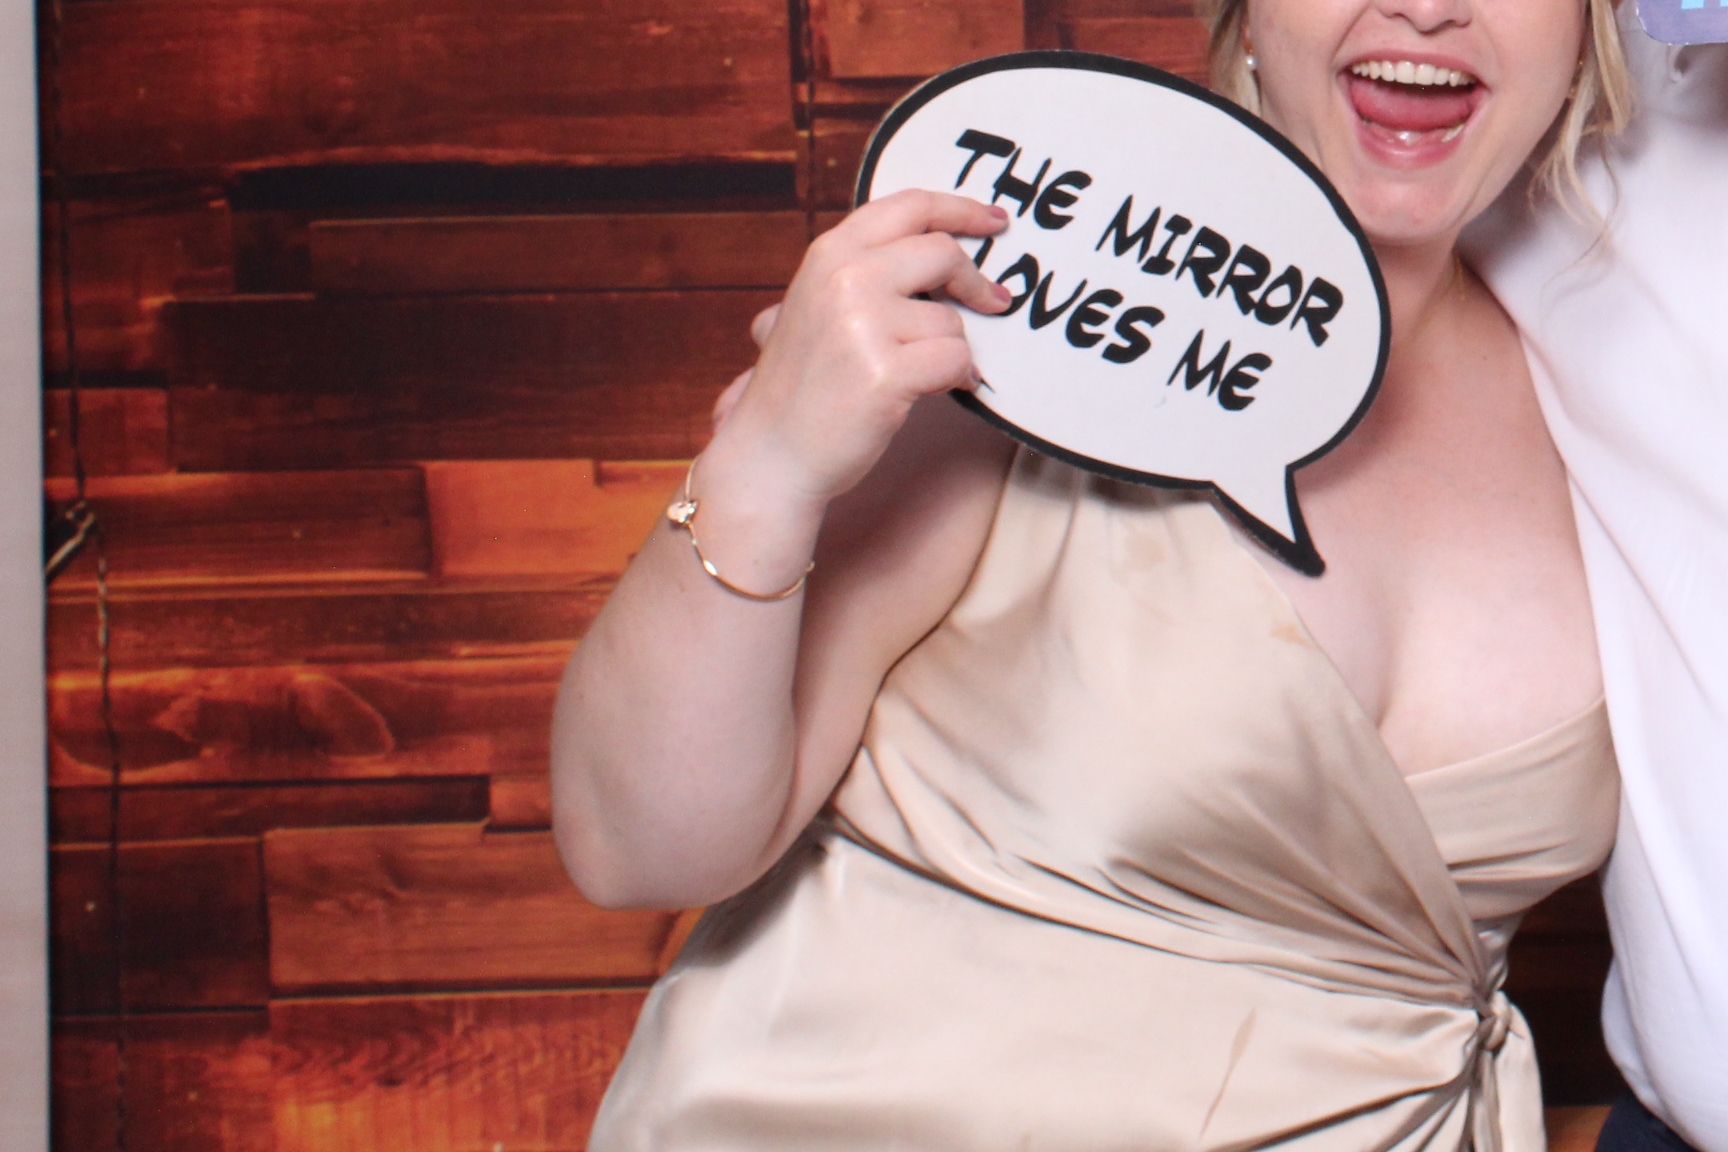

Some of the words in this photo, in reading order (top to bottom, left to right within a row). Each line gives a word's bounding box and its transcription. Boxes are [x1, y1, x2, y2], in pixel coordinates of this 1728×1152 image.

[954, 129, 1093, 230] THE
[1095, 194, 1343, 347] MIRROR
[1167, 328, 1273, 411] ME
